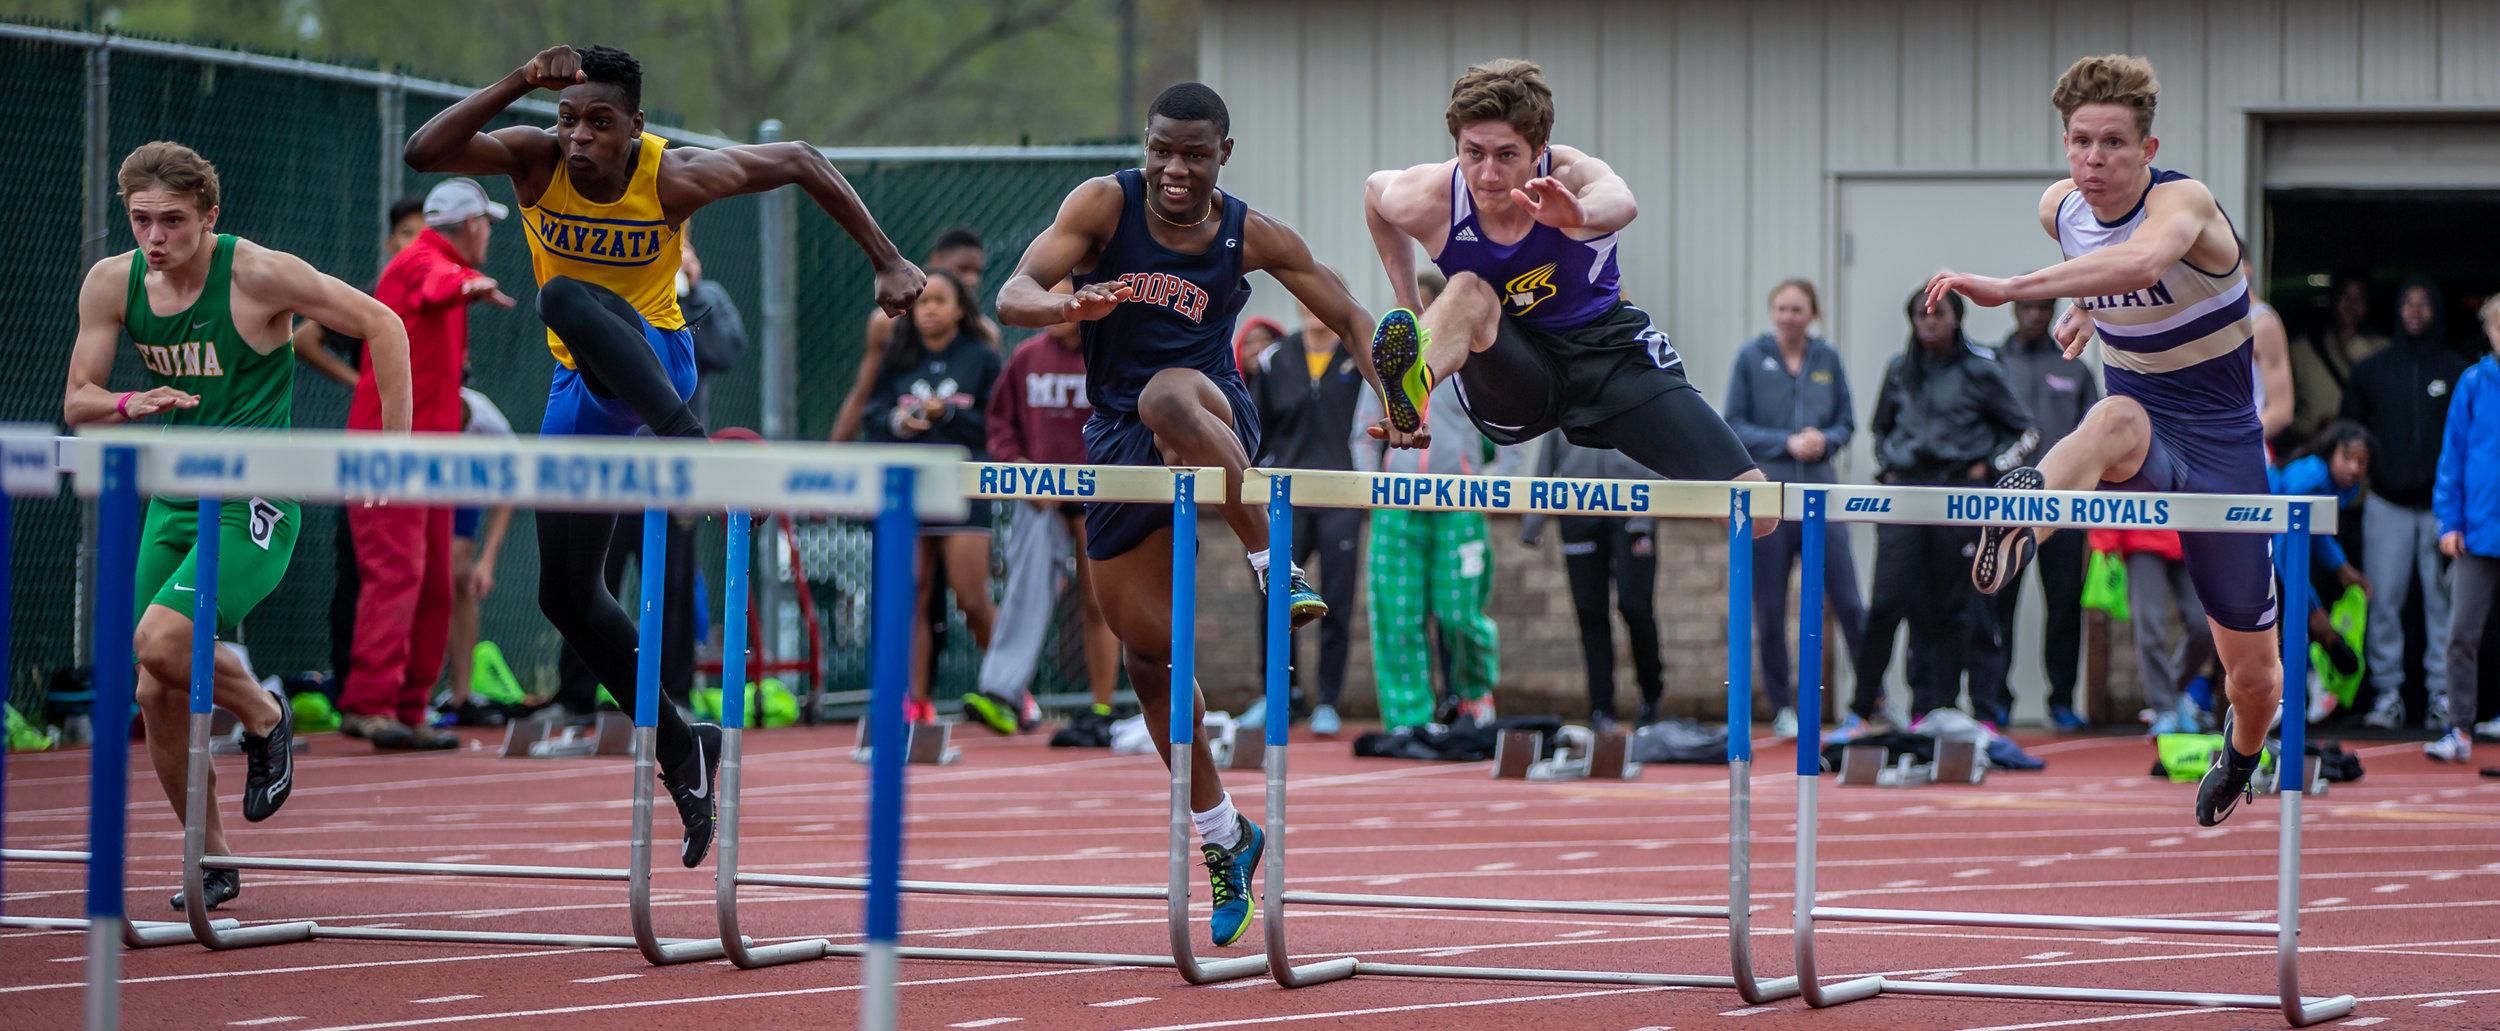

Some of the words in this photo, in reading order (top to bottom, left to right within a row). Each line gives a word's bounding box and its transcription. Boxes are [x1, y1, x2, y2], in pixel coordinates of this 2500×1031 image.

[539, 212, 661, 258] WAYZATA
[1509, 291, 1535, 307] W
[134, 341, 224, 377] EDINA
[336, 448, 519, 495] HOPKINS
[535, 453, 694, 498] ROYALS
[980, 466, 1096, 496] ROYALS
[1371, 476, 1511, 508] HOPKINS
[1530, 480, 1650, 512] ROYALS
[1845, 497, 1892, 512] GILL
[1947, 495, 2060, 522] HOPKINS
[2071, 498, 2169, 525] ROYALS
[252, 502, 278, 541] 5
